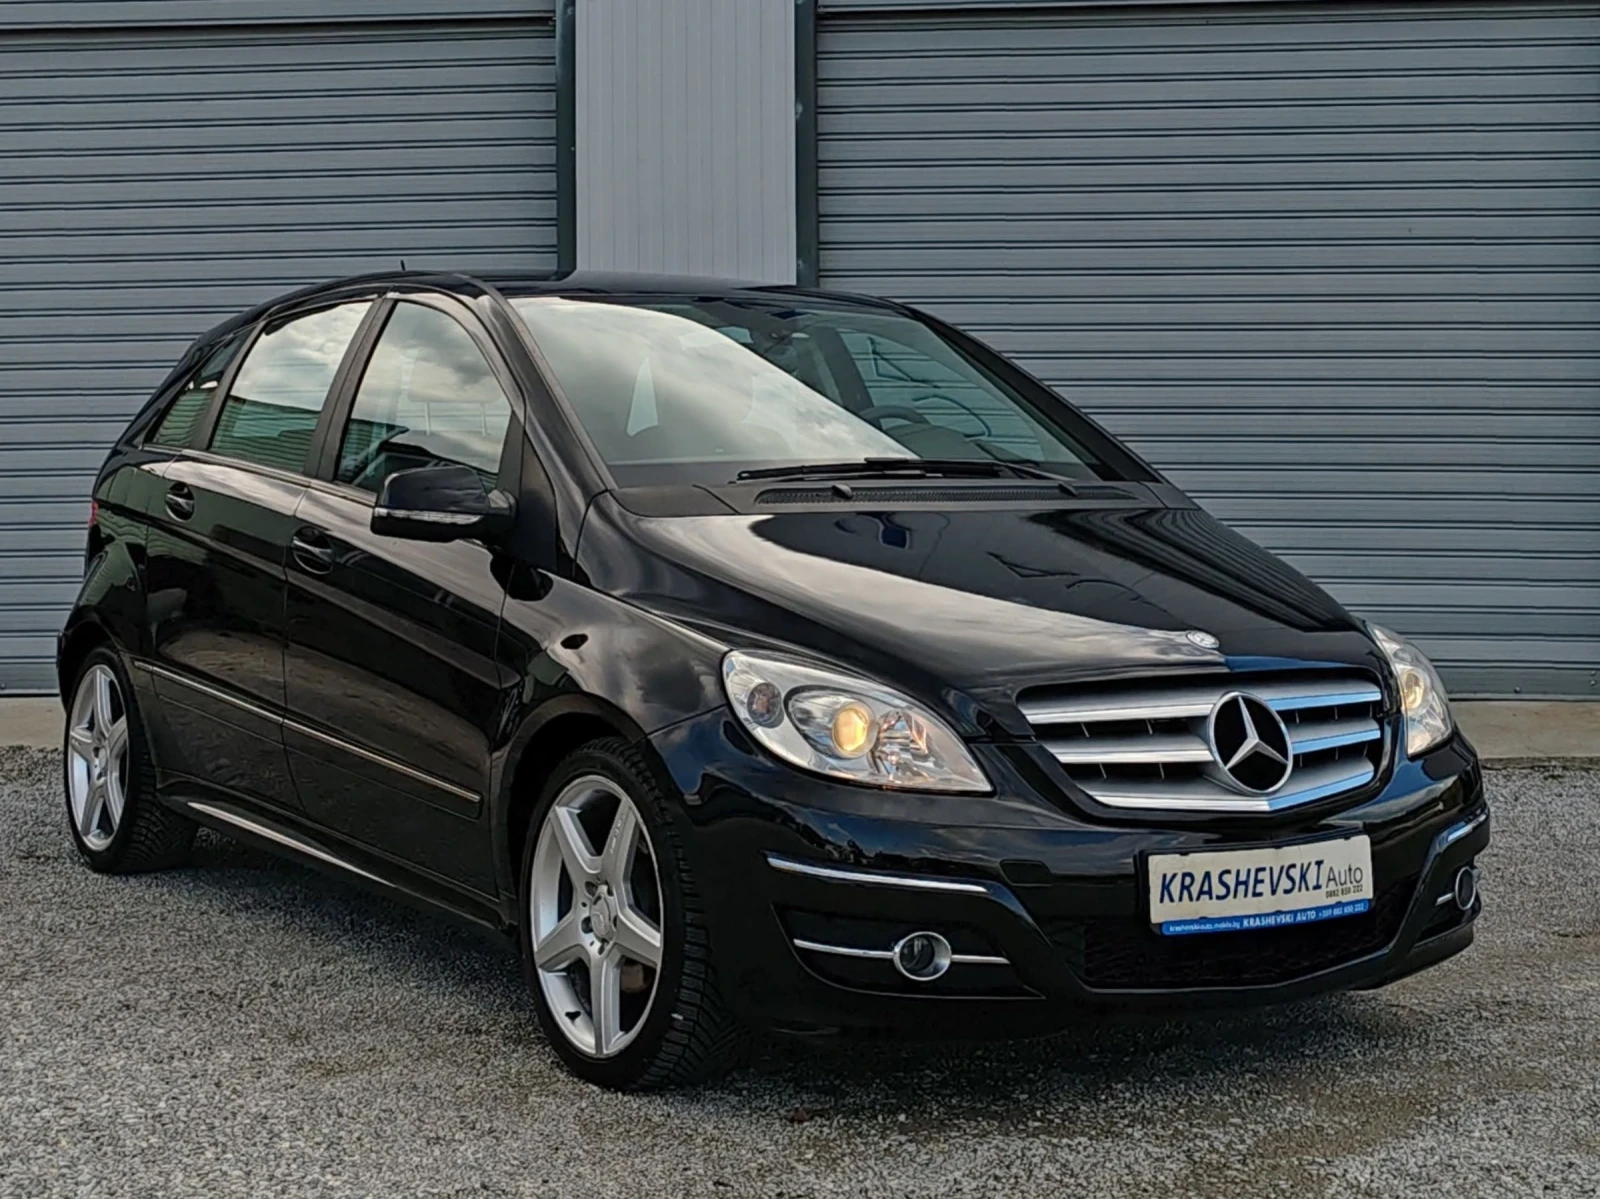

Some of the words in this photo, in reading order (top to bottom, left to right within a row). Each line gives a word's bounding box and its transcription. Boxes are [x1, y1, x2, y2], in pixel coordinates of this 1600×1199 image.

[1159, 860, 1324, 904] KRASHEVSKI
[1325, 864, 1363, 889] Auto
[1352, 884, 1363, 893] 222
[1242, 913, 1294, 928] KRASHEVSKI
[1296, 910, 1316, 922] AUTO
[1354, 902, 1364, 912] 222
